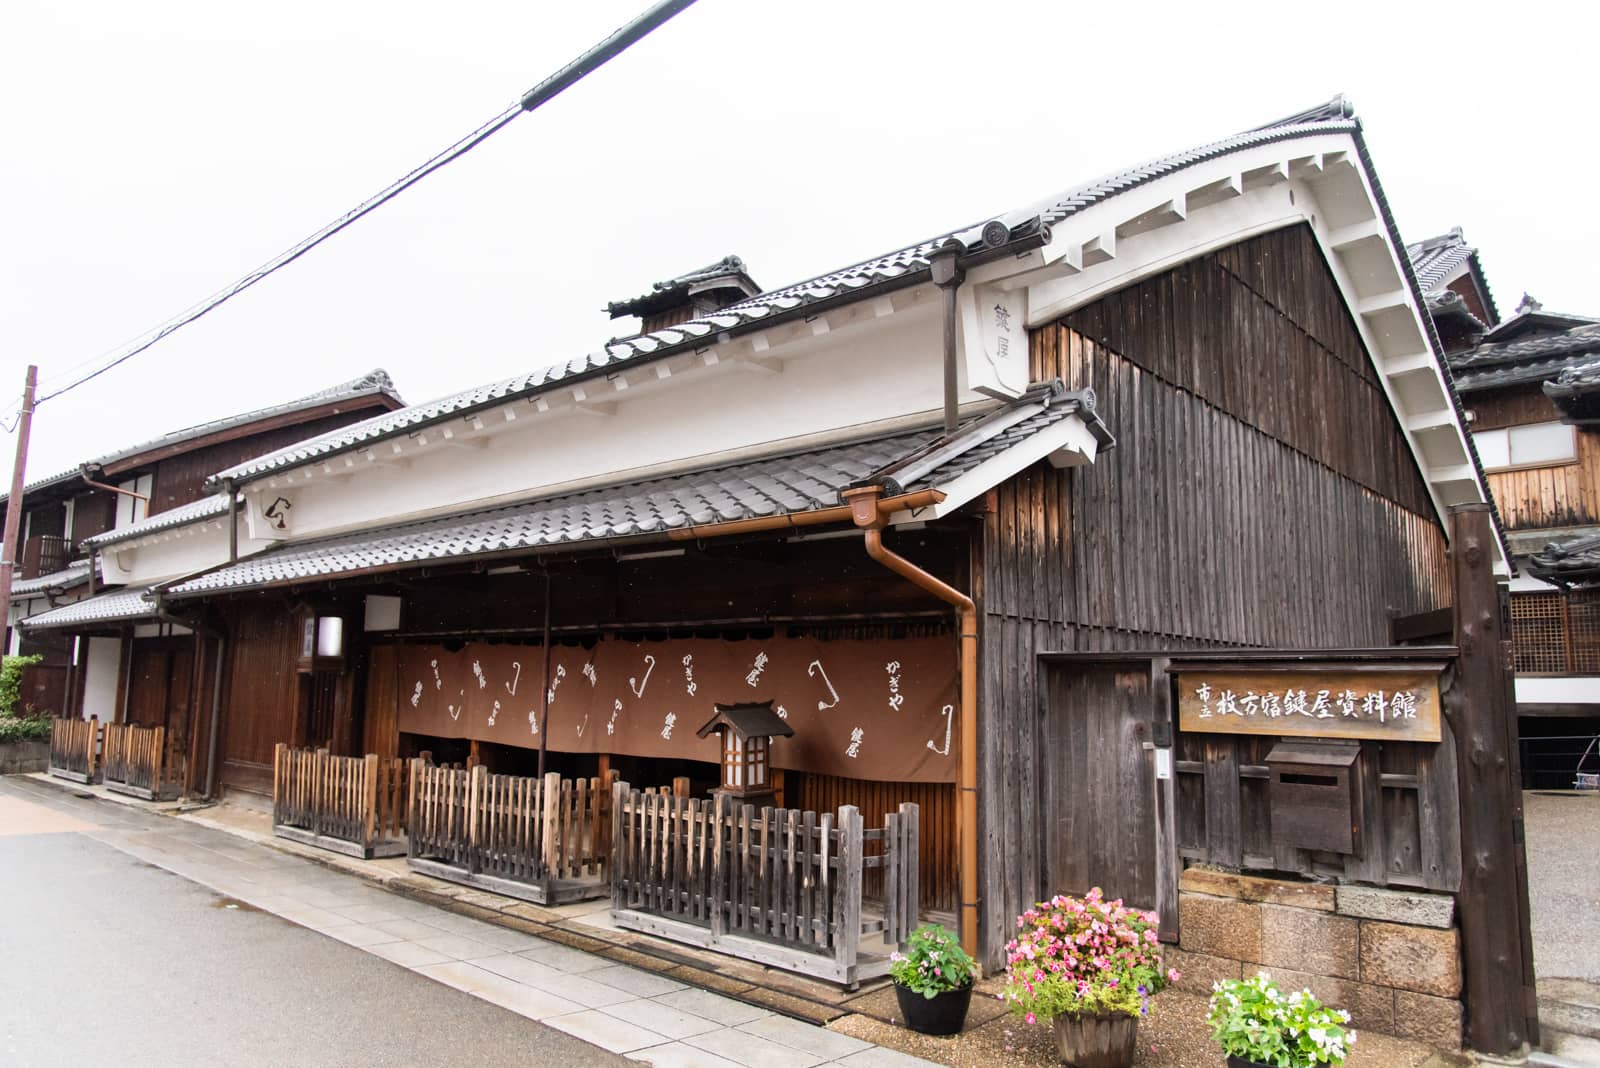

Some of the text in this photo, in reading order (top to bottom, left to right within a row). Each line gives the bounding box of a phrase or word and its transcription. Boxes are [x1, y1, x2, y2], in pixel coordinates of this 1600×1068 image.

[884, 660, 905, 711] かぎや
[1196, 683, 1213, 718] 市立
